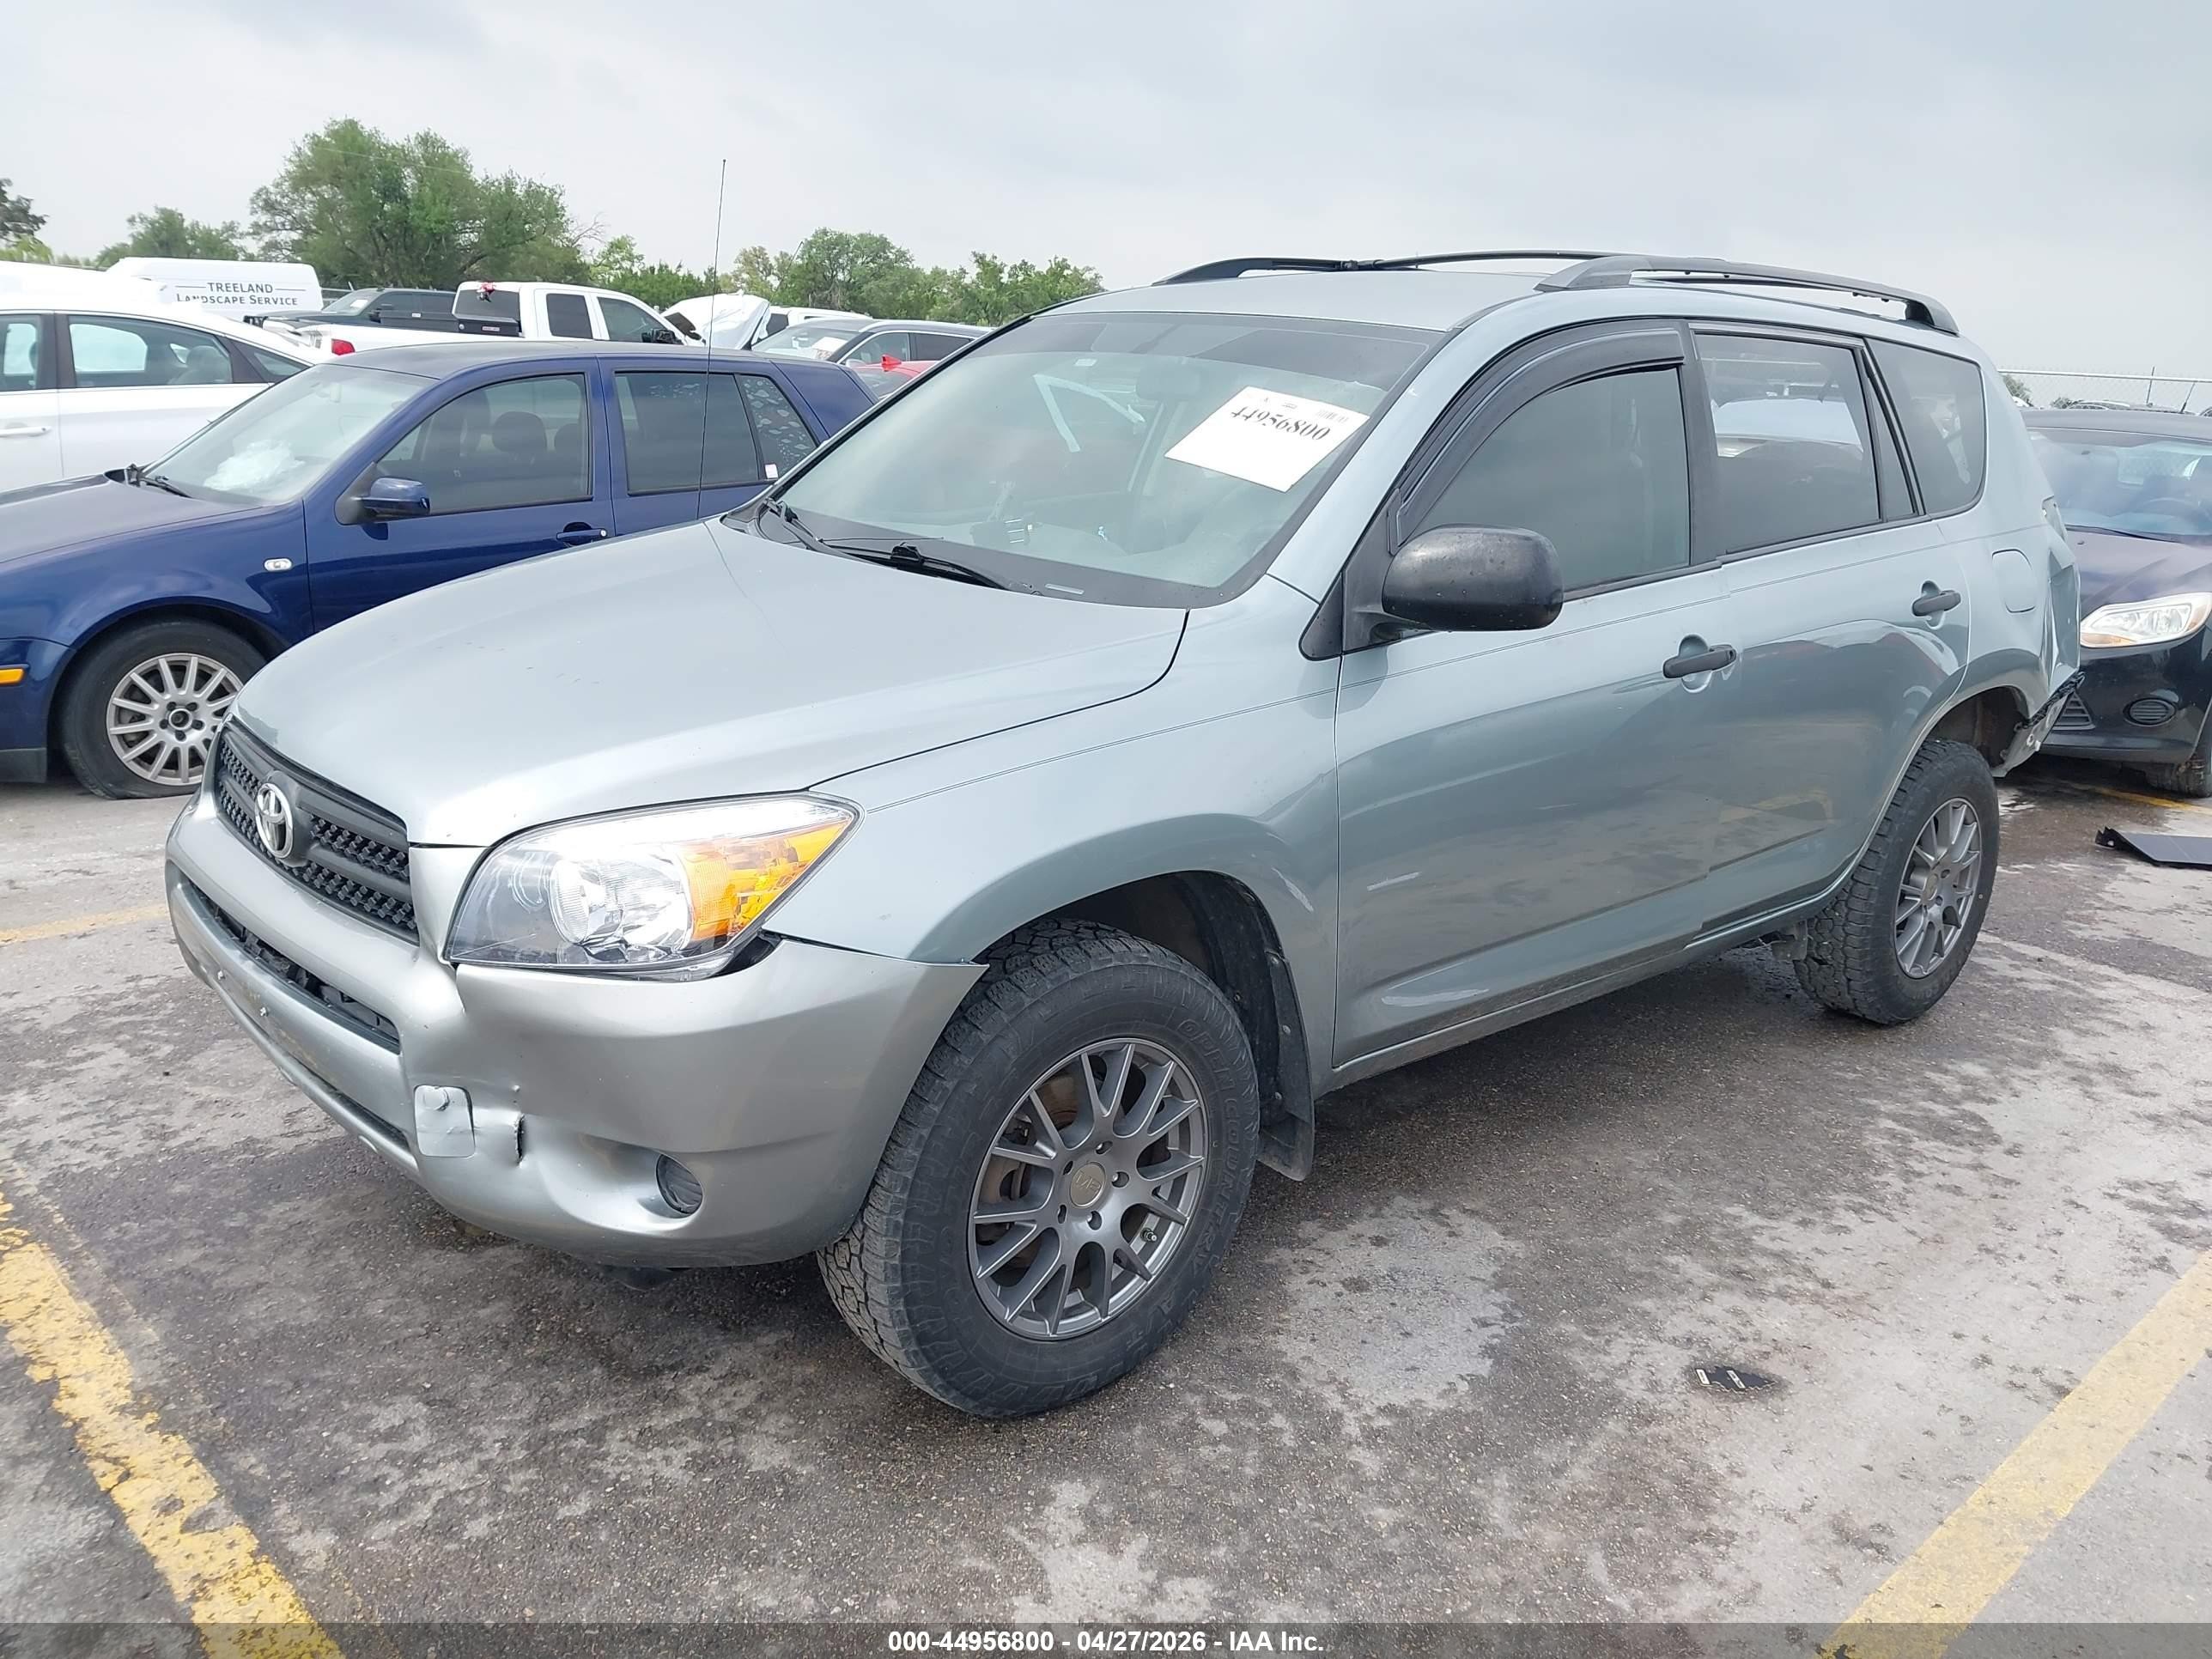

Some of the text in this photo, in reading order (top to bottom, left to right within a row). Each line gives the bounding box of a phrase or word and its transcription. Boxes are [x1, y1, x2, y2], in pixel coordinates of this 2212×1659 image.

[207, 283, 273, 294] TREELAND
[249, 295, 298, 306] SERVICE
[1231, 406, 1331, 441] 44956800
